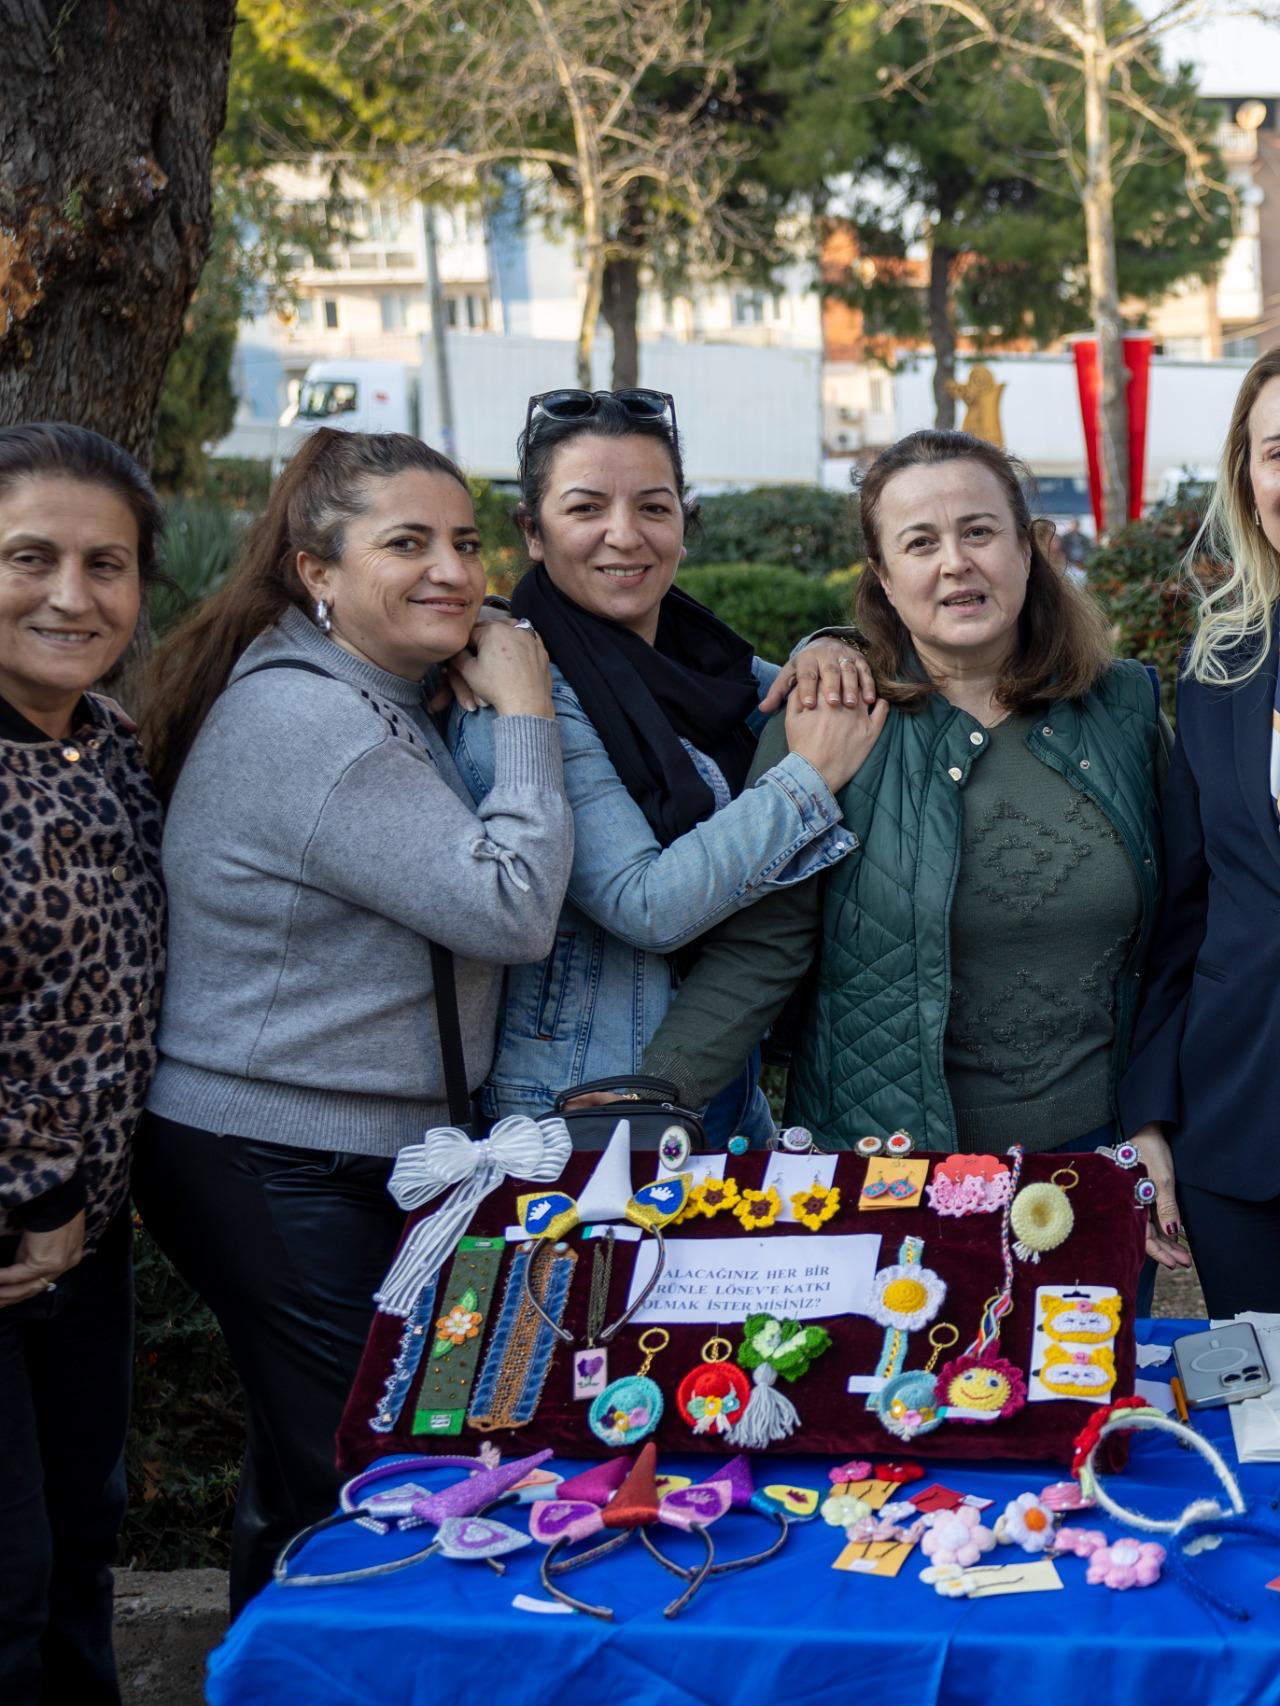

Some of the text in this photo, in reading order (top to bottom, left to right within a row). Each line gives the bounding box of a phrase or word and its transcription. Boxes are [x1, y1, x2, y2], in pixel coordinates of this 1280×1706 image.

[664, 1266, 830, 1280] ALACAĞINIZ HER BİR
[655, 1281, 831, 1296] RÜNLE LÖSEV'E KATKI
[707, 1298, 751, 1312] İSTER
[755, 1297, 822, 1312] MİSİNİZ?
